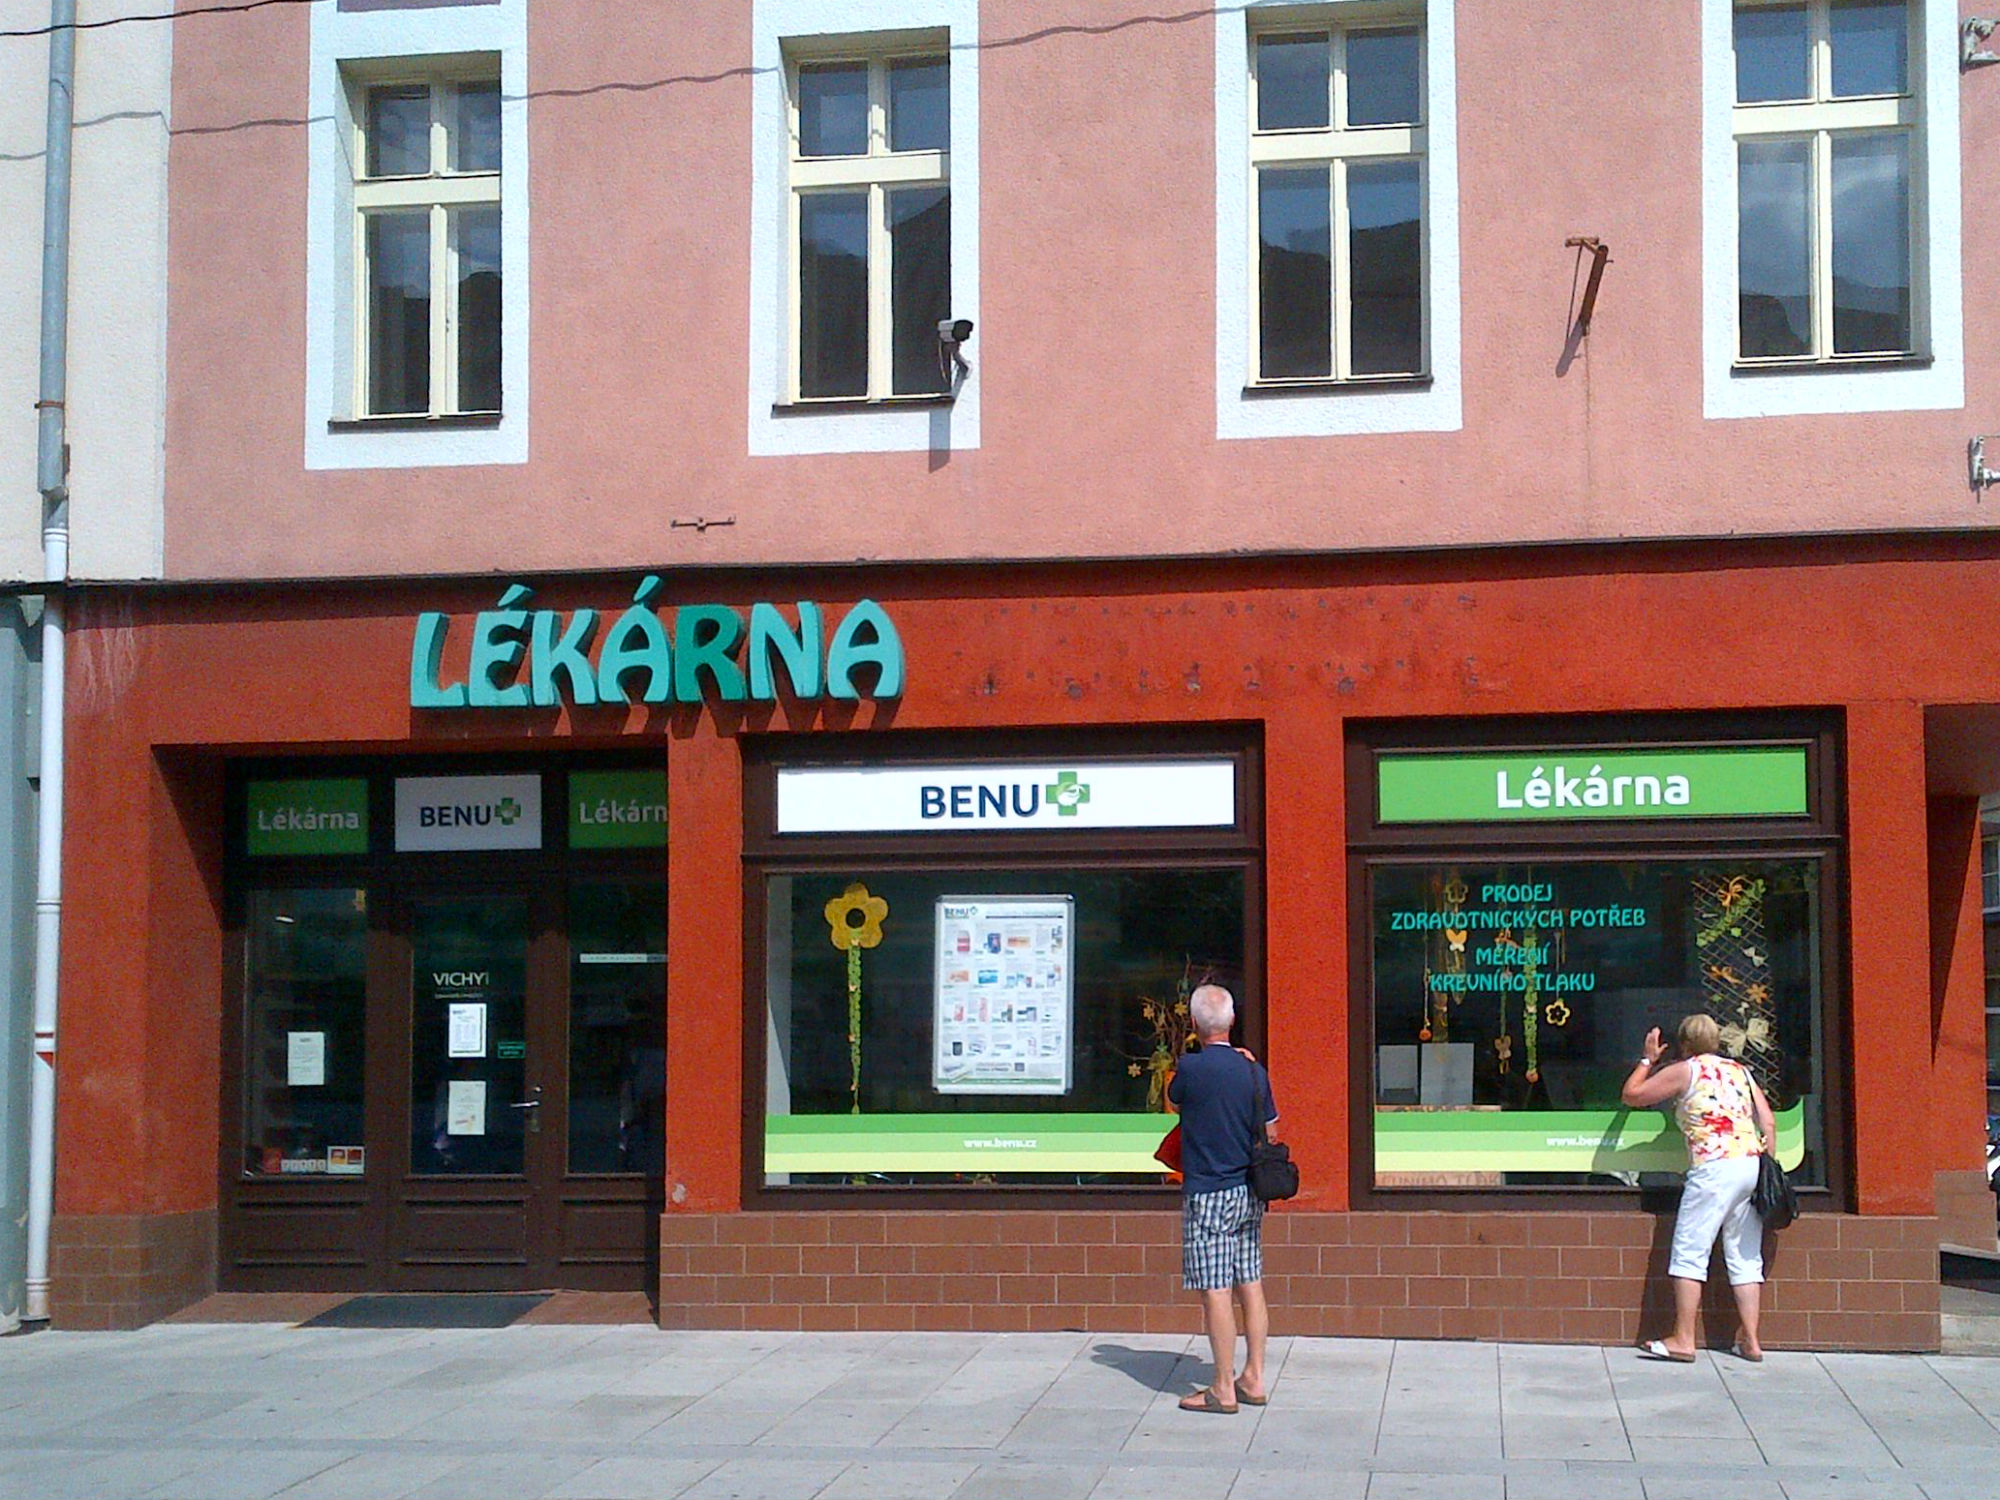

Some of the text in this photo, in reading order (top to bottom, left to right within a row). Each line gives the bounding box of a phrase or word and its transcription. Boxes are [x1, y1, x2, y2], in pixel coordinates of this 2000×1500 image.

[410, 575, 904, 707] LÉKÁRNA
[1497, 764, 1690, 808] Lékárna
[921, 784, 1039, 819] BENU
[258, 806, 360, 831] Lékárna
[420, 806, 492, 828] BENU
[1482, 884, 1553, 903] PRODEJ
[1569, 904, 1646, 928] POTŘEB
[1534, 973, 1595, 991] TLAKU
[963, 1137, 1037, 1148] www.benu.cz
